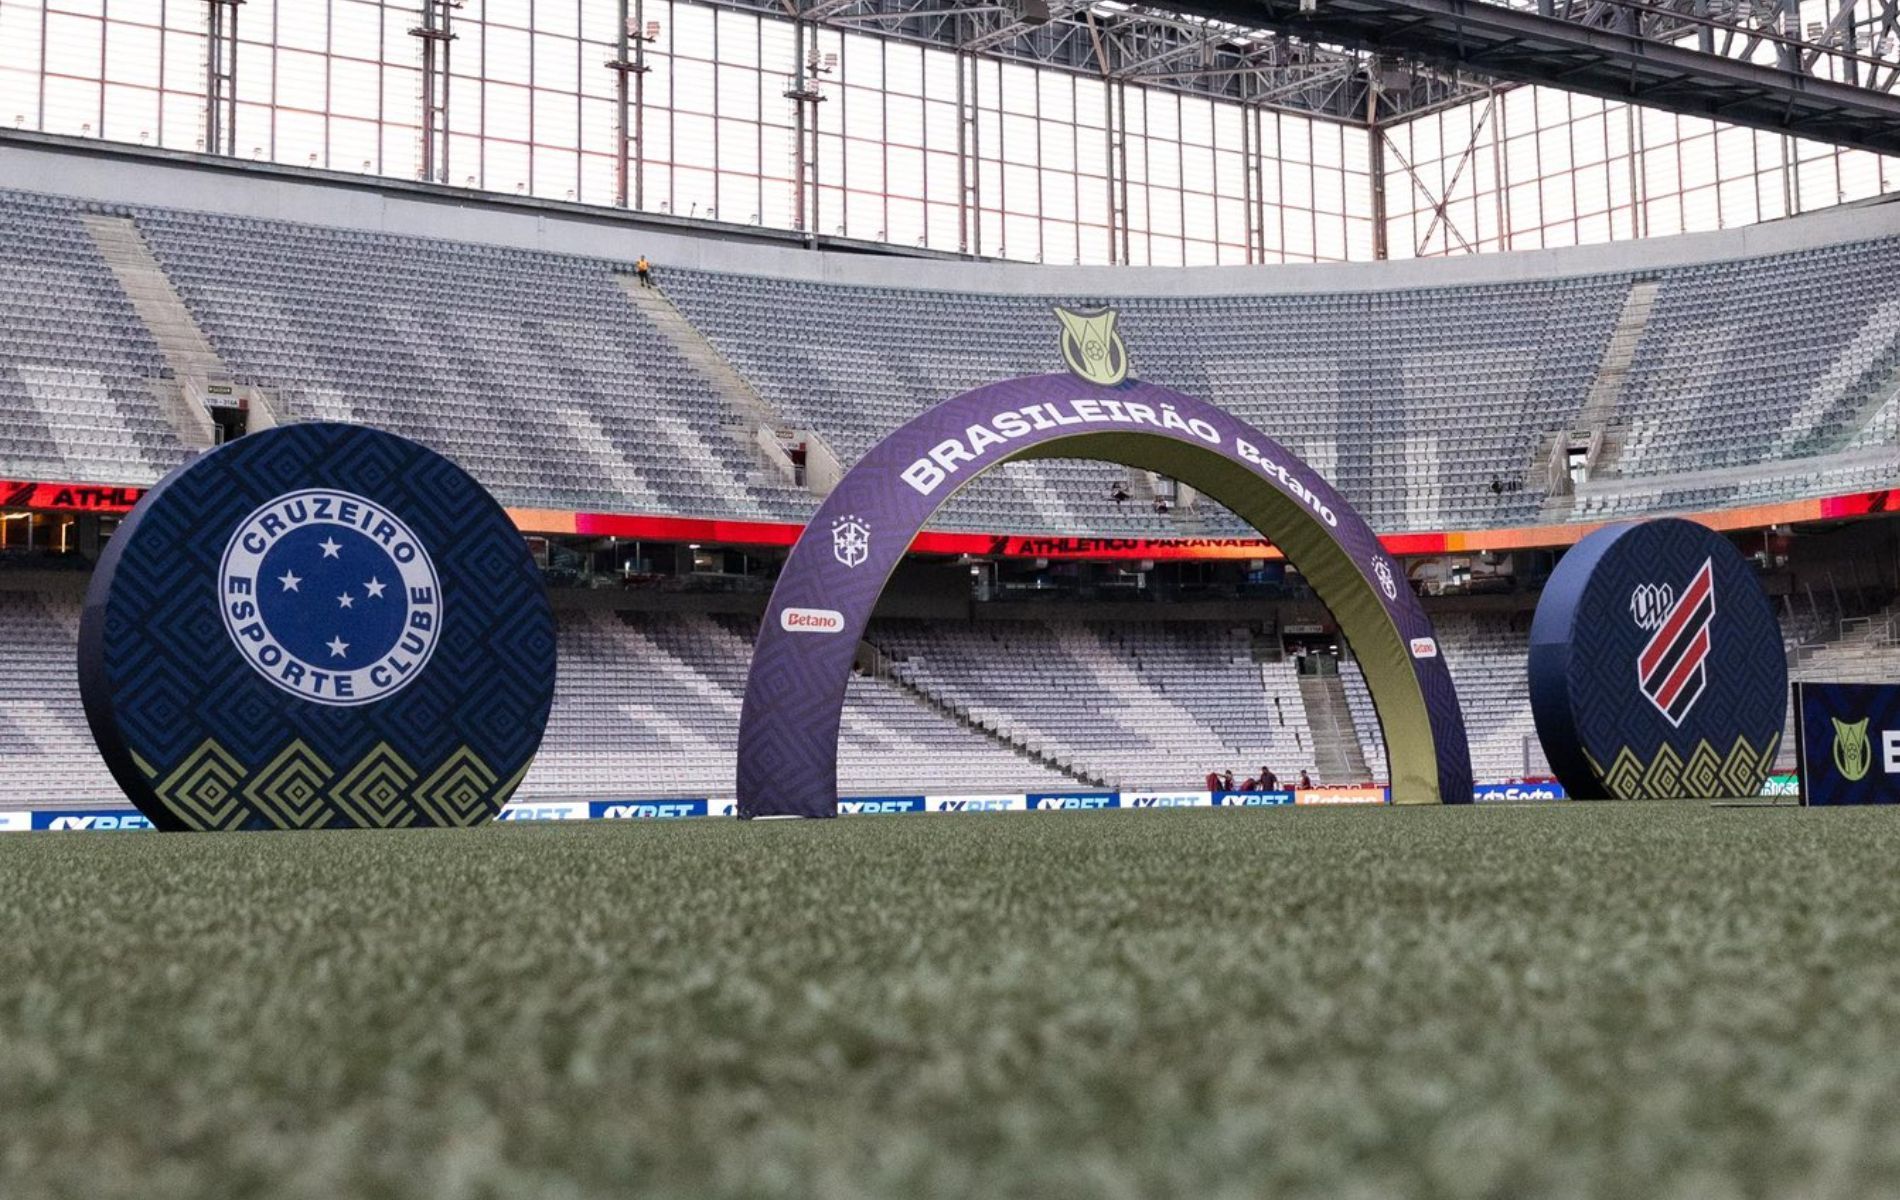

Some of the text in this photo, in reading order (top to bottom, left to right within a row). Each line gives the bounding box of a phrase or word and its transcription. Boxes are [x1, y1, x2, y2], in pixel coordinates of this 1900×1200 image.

[901, 400, 1222, 495] BRASILEIRÃO
[1236, 437, 1338, 528] Betano
[242, 498, 416, 564] CRUZEIRO
[229, 575, 433, 697] ESPORTE CLUBE
[787, 613, 837, 627] Betano
